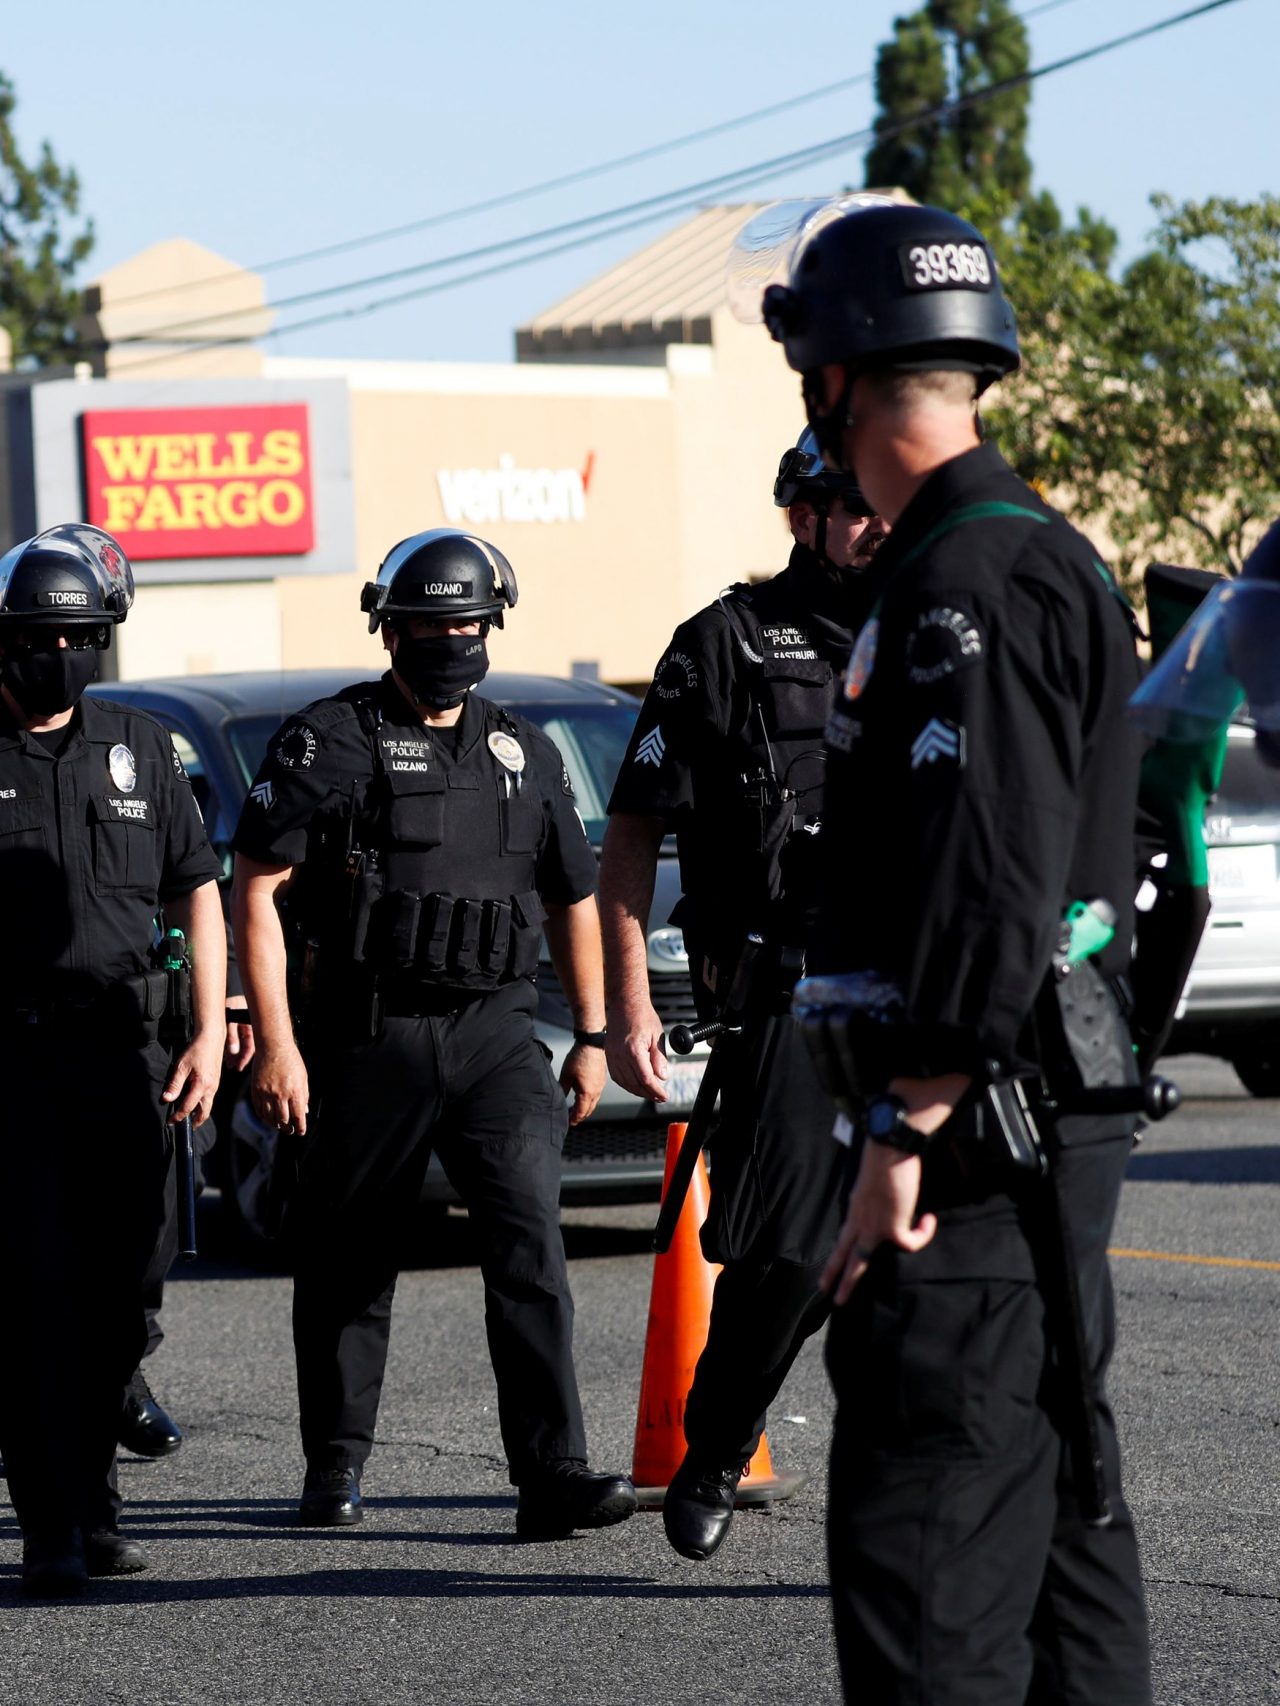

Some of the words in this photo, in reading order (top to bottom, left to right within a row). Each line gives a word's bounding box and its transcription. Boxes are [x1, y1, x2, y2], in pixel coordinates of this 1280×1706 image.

[909, 243, 991, 286] 39369
[91, 429, 304, 482] WELLS
[436, 452, 586, 523] verizon
[101, 478, 305, 532] FARGO
[425, 583, 463, 595] LOZANO
[48, 592, 88, 605] TORRES
[763, 629, 781, 638] LOS
[772, 635, 810, 646] POLICE
[774, 650, 818, 660] EASTBURN
[669, 651, 698, 688] ANGELES
[656, 685, 681, 699] POLICE
[298, 726, 316, 767] ANGELES
[382, 740, 398, 748] LOS
[398, 741, 429, 750] ANGELES
[390, 748, 425, 757] POLICE
[392, 761, 428, 772] LOZANO
[109, 799, 123, 807] LOS
[123, 800, 148, 810] ANGELES
[117, 807, 147, 820] POLICE
